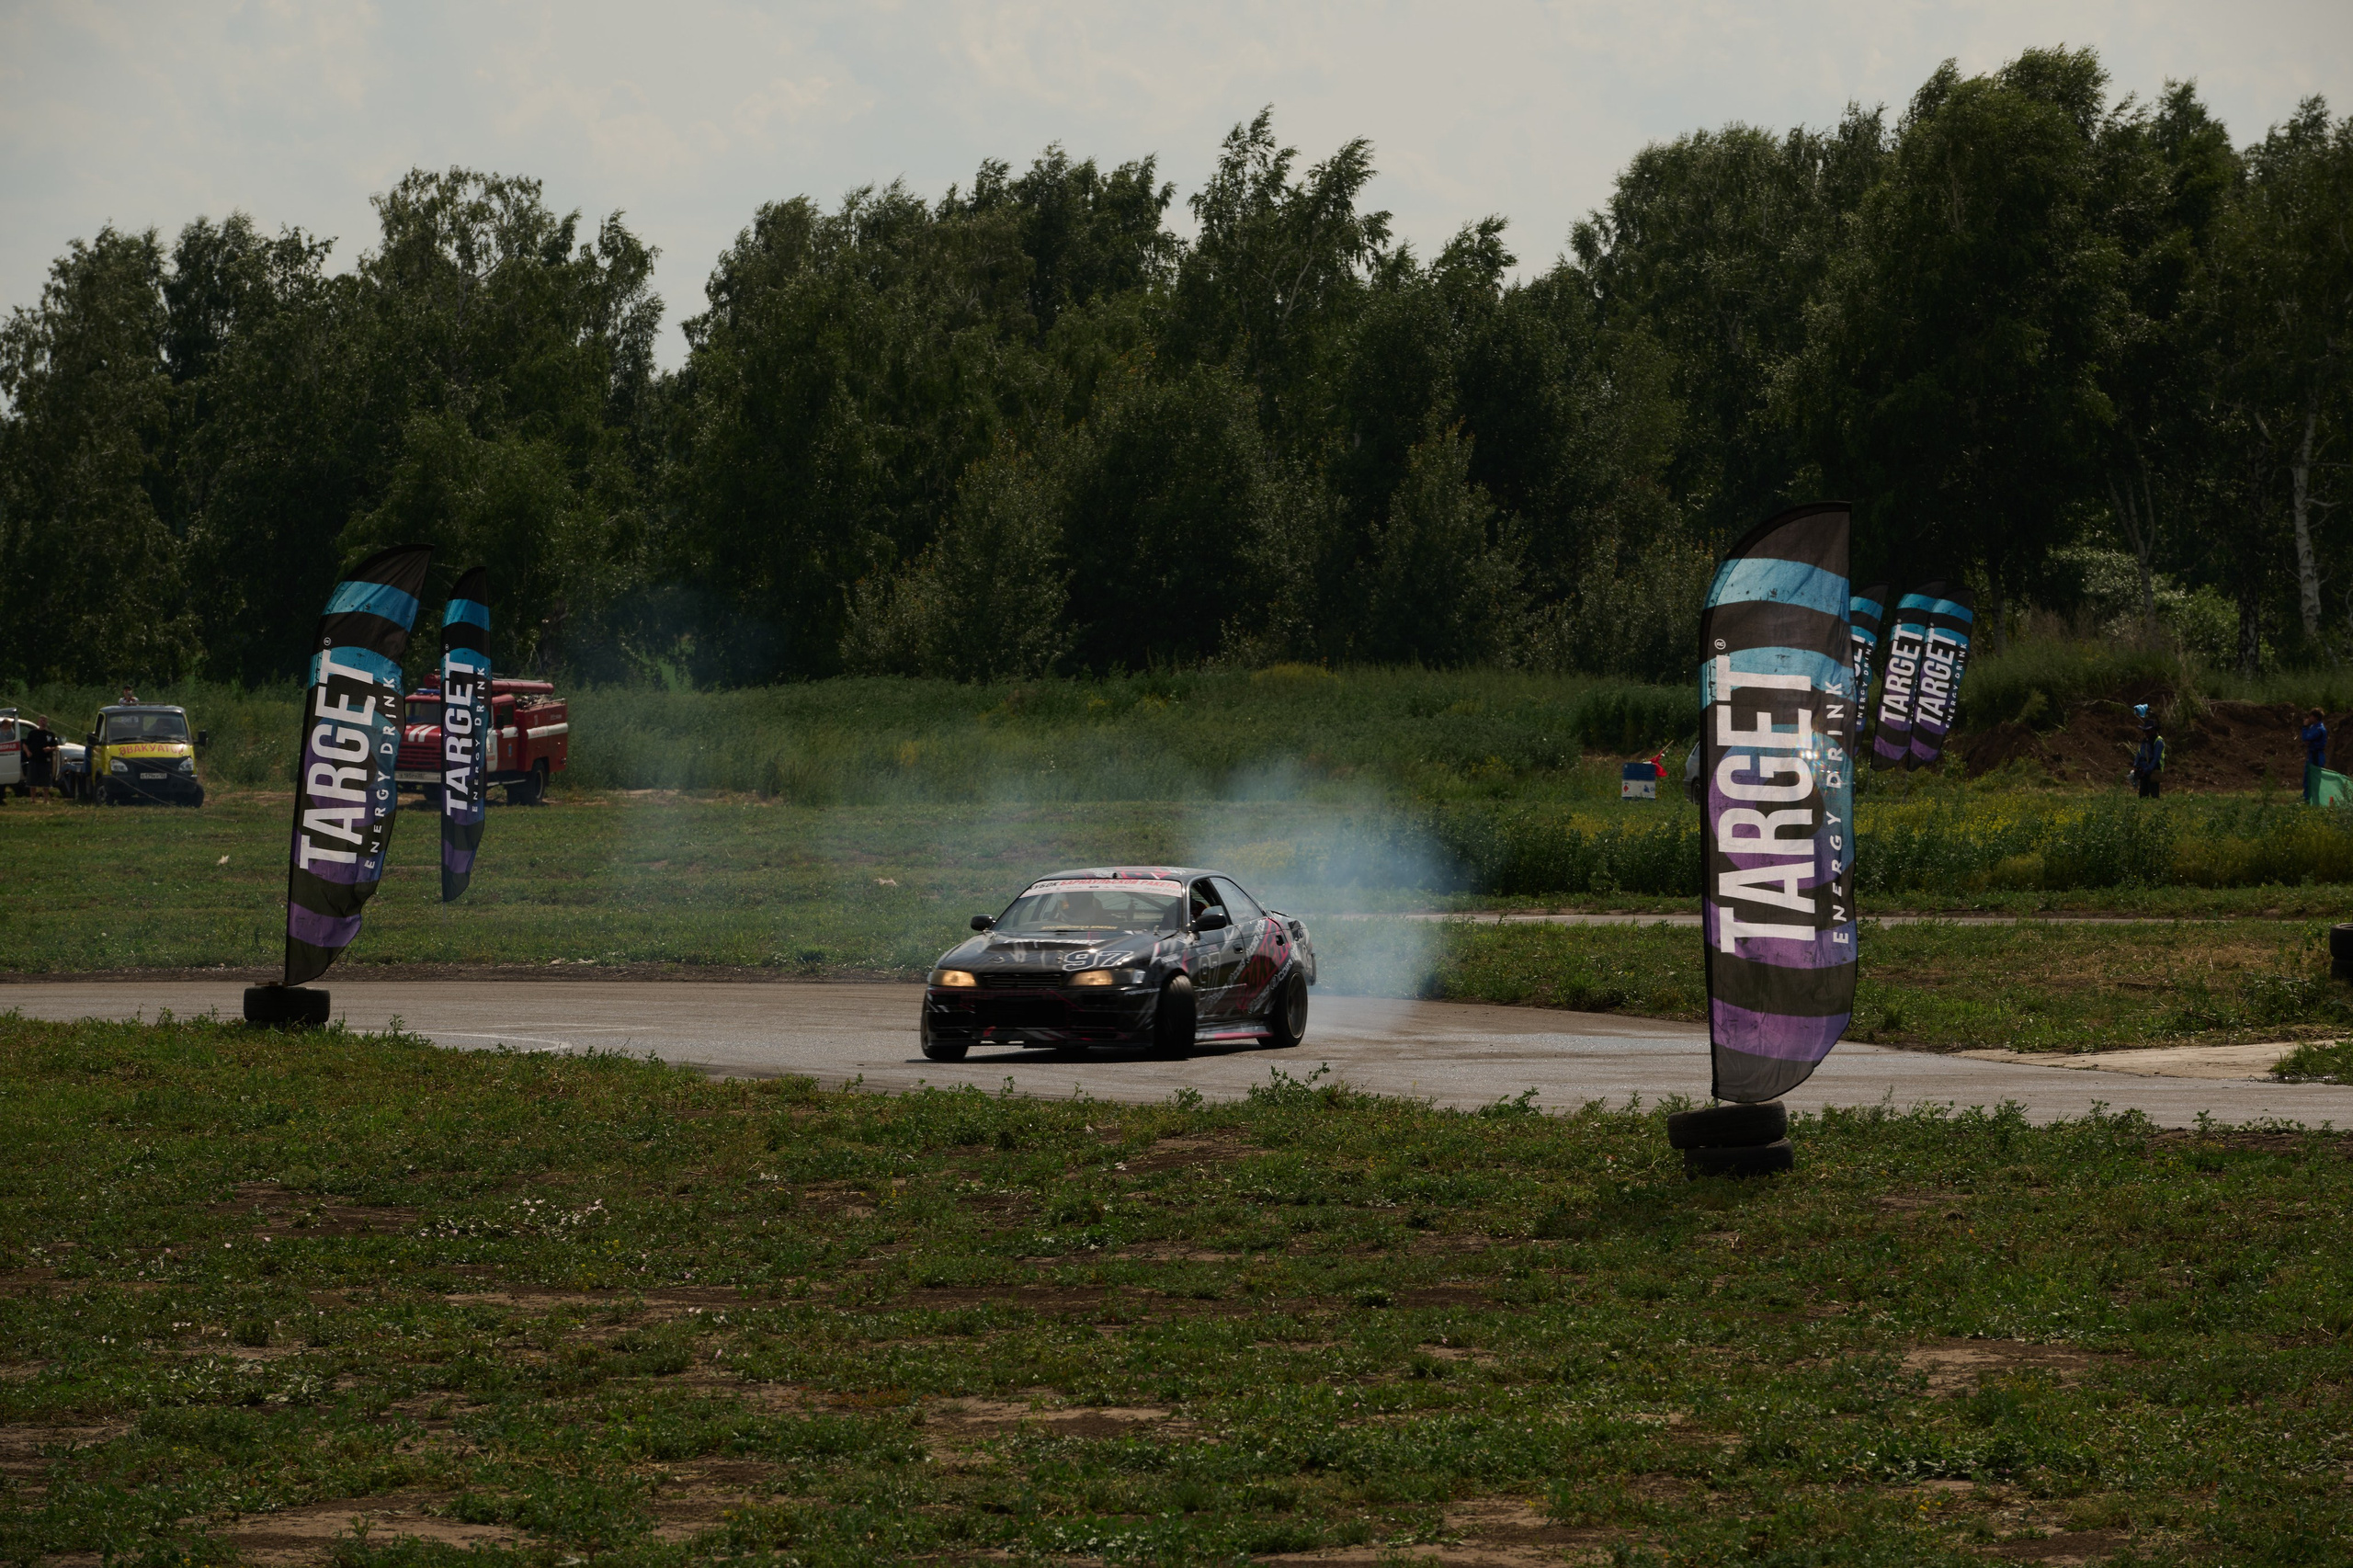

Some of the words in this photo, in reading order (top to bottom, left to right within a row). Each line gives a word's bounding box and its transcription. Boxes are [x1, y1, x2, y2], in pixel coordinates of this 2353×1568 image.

[475, 666, 485, 727] DRINK
[1856, 681, 1868, 726] ENERGY
[1863, 640, 1874, 676] DRINK
[1881, 624, 1923, 723] TARGET
[1915, 629, 1958, 726] TARGET
[1945, 685, 1959, 729] ENERGY
[1955, 643, 1968, 679] DRINK
[299, 649, 376, 870] TARGET
[364, 770, 392, 869] ENERGY
[380, 676, 397, 756] DRINK
[445, 652, 475, 817] TARGET
[472, 738, 482, 813] ENERGY
[1824, 680, 1844, 790] DRINK
[1715, 654, 1817, 953] TARGET
[1825, 810, 1849, 944] ENERGY
[1062, 949, 1135, 972] 97
[1199, 951, 1222, 1001] 97
